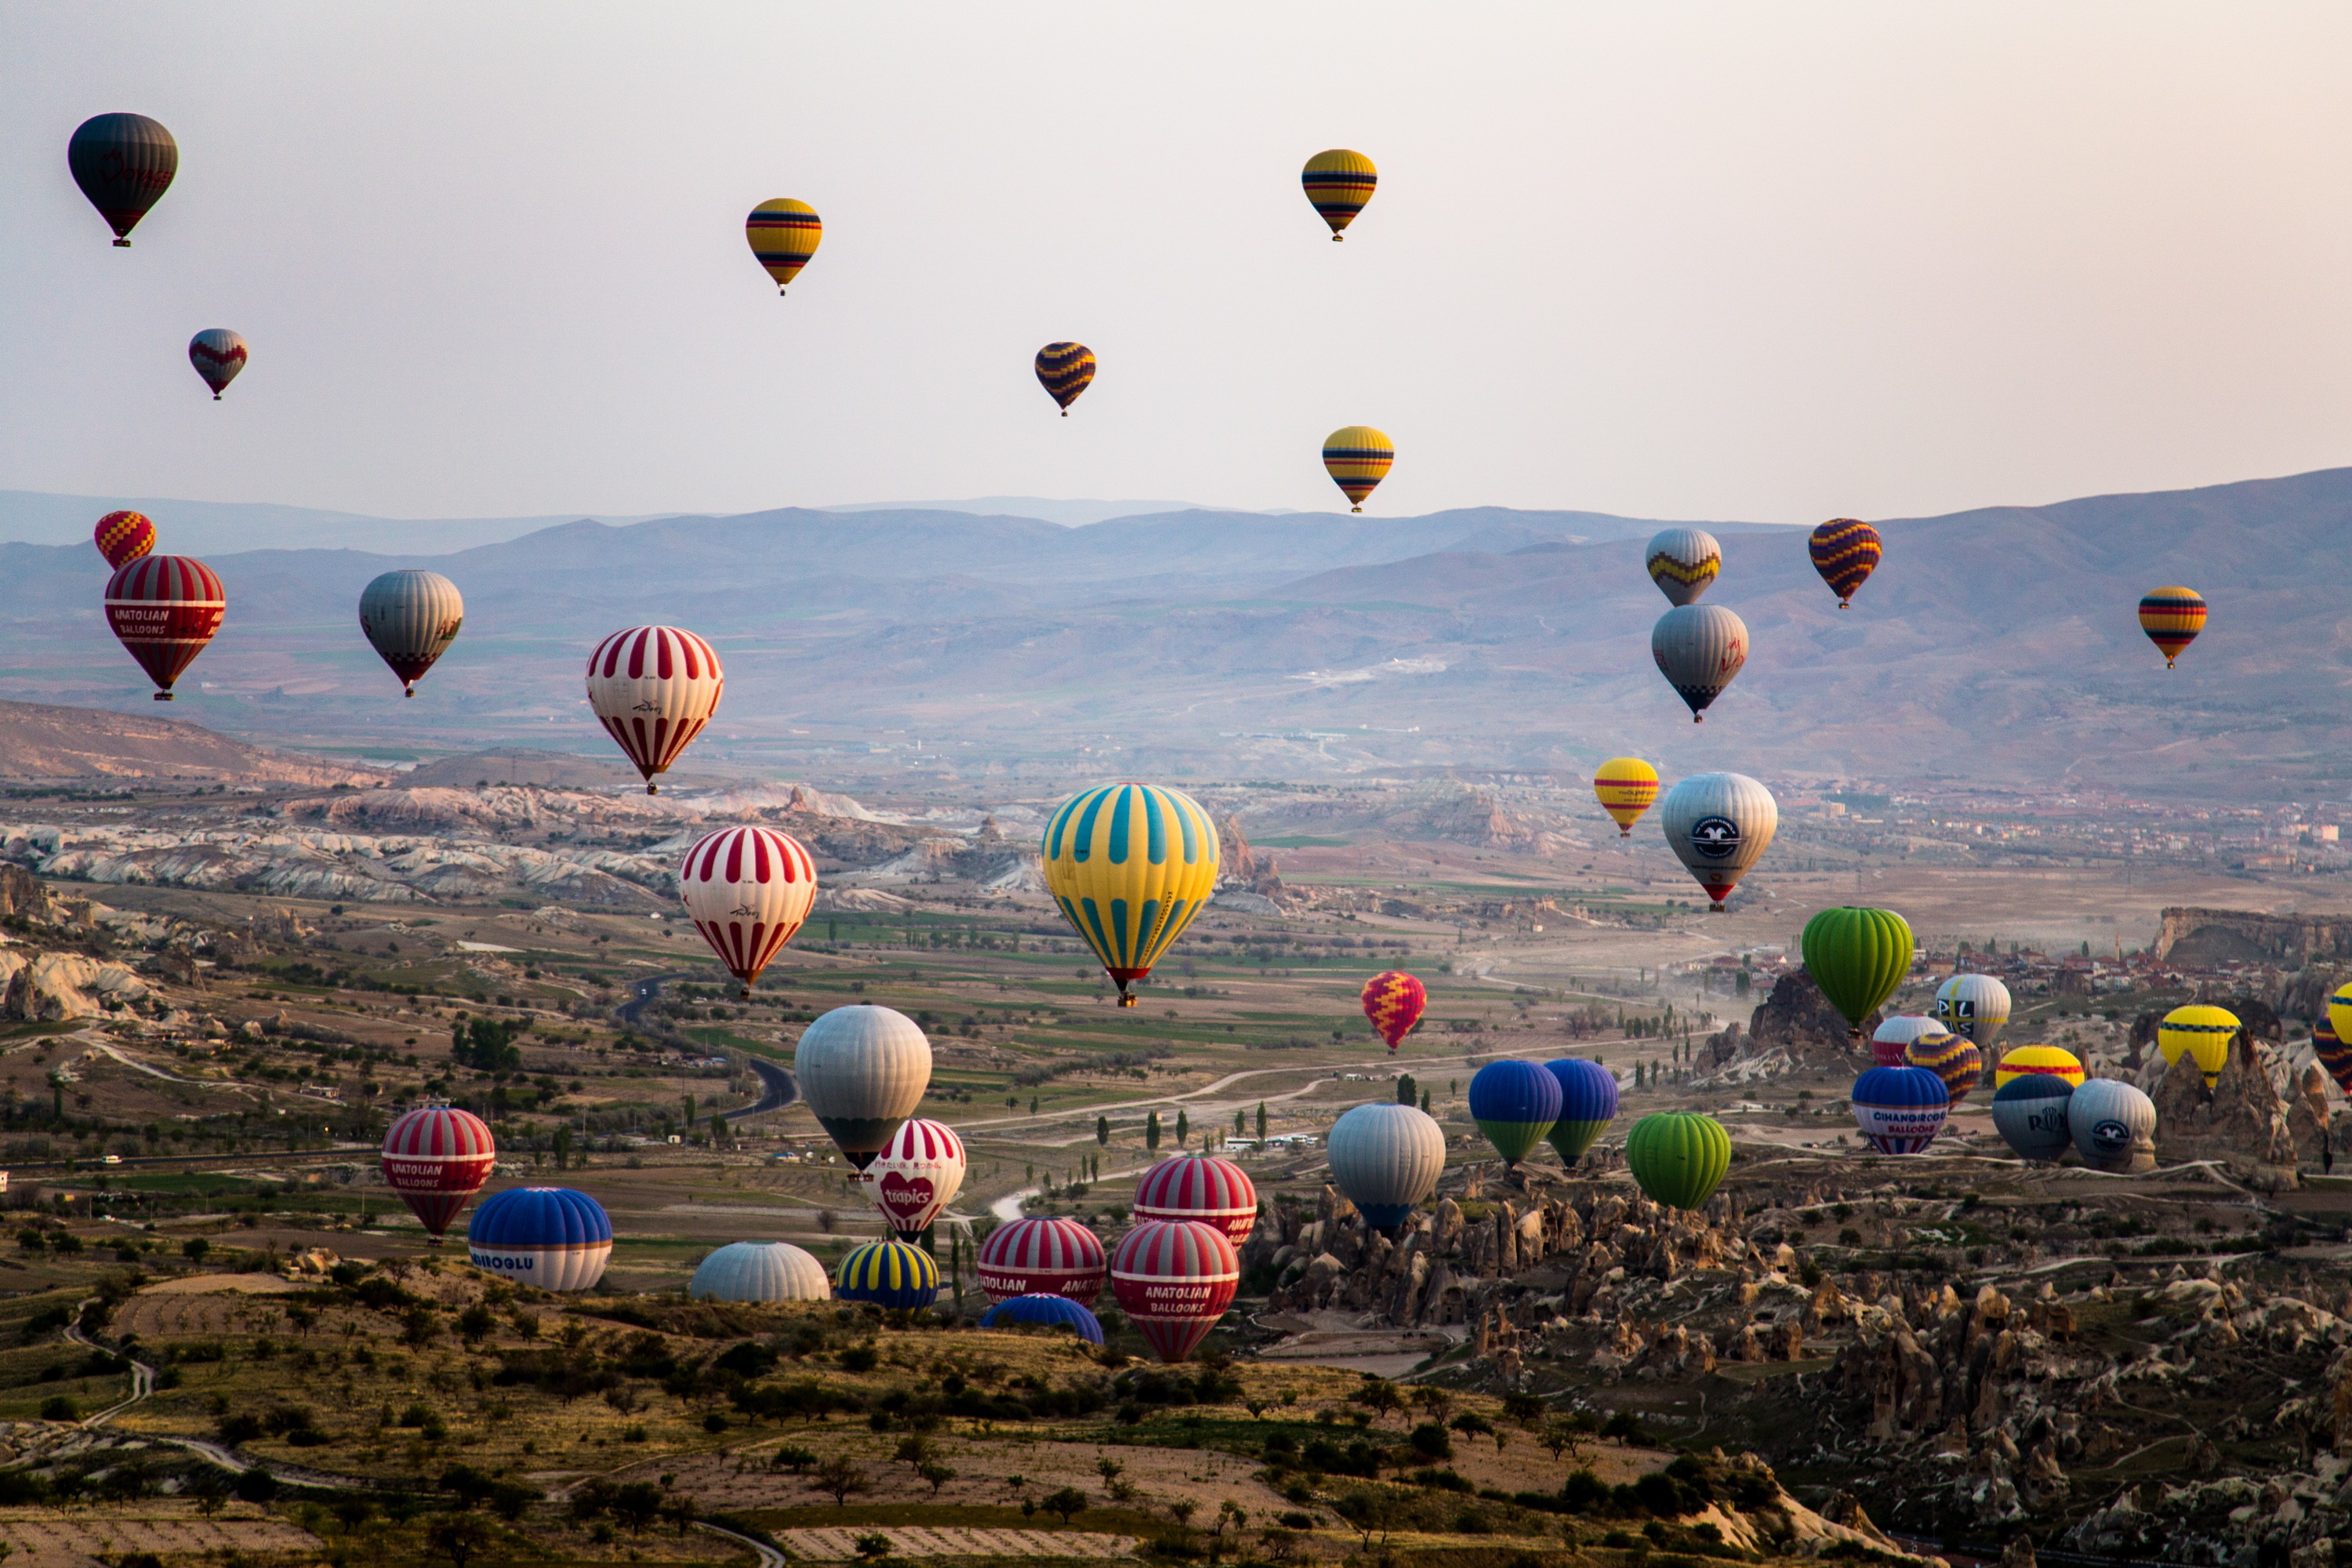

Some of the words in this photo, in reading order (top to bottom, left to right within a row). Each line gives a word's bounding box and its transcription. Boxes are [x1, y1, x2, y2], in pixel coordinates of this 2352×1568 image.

[115, 610, 169, 622] ANATOLIAN
[120, 625, 165, 634] BALLOONS
[392, 1163, 442, 1175] ANATOLIAN
[396, 1178, 439, 1188] BALLOONS
[885, 1188, 930, 1206] trapics
[1145, 1287, 1212, 1299] ANATOLIAN
[1151, 1302, 1206, 1313] BALLOONS
